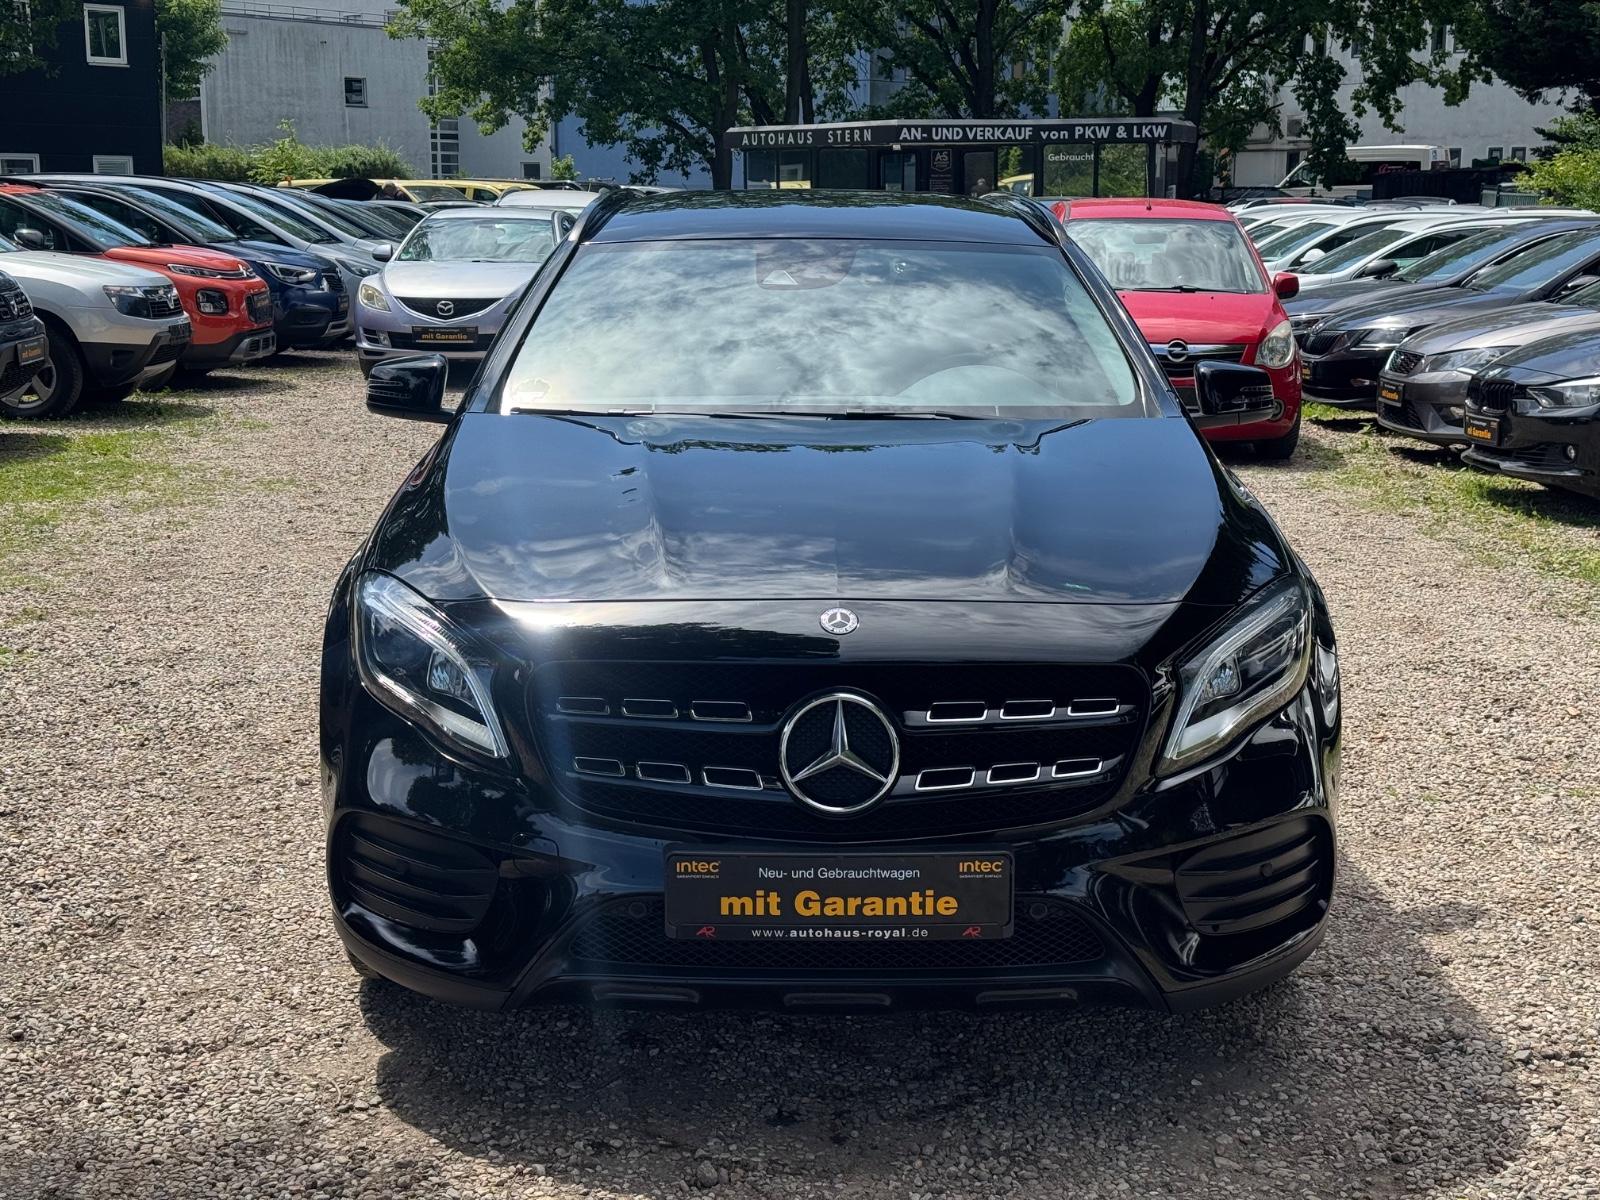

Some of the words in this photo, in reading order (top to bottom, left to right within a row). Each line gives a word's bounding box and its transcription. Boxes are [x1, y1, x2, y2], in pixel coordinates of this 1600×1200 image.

[741, 131, 813, 146] AUTOHAUS
[827, 128, 872, 143] STERN
[900, 127, 928, 140] AN-
[932, 127, 963, 140] UND
[965, 126, 1033, 140] VERKAUF
[1040, 130, 1069, 140] von
[1074, 125, 1111, 139] PKW
[1115, 125, 1128, 139] &
[1133, 124, 1168, 138] LKW
[1047, 152, 1095, 161] Gebraucht
[676, 860, 720, 873] intec
[959, 859, 1004, 873] intec
[758, 867, 788, 879] Neu-
[791, 868, 814, 879] und
[817, 867, 921, 881] Gebrauchtwagen
[720, 889, 781, 916] mit
[794, 889, 959, 917] Garantie
[751, 927, 929, 940] www.autohaus-royal.de
